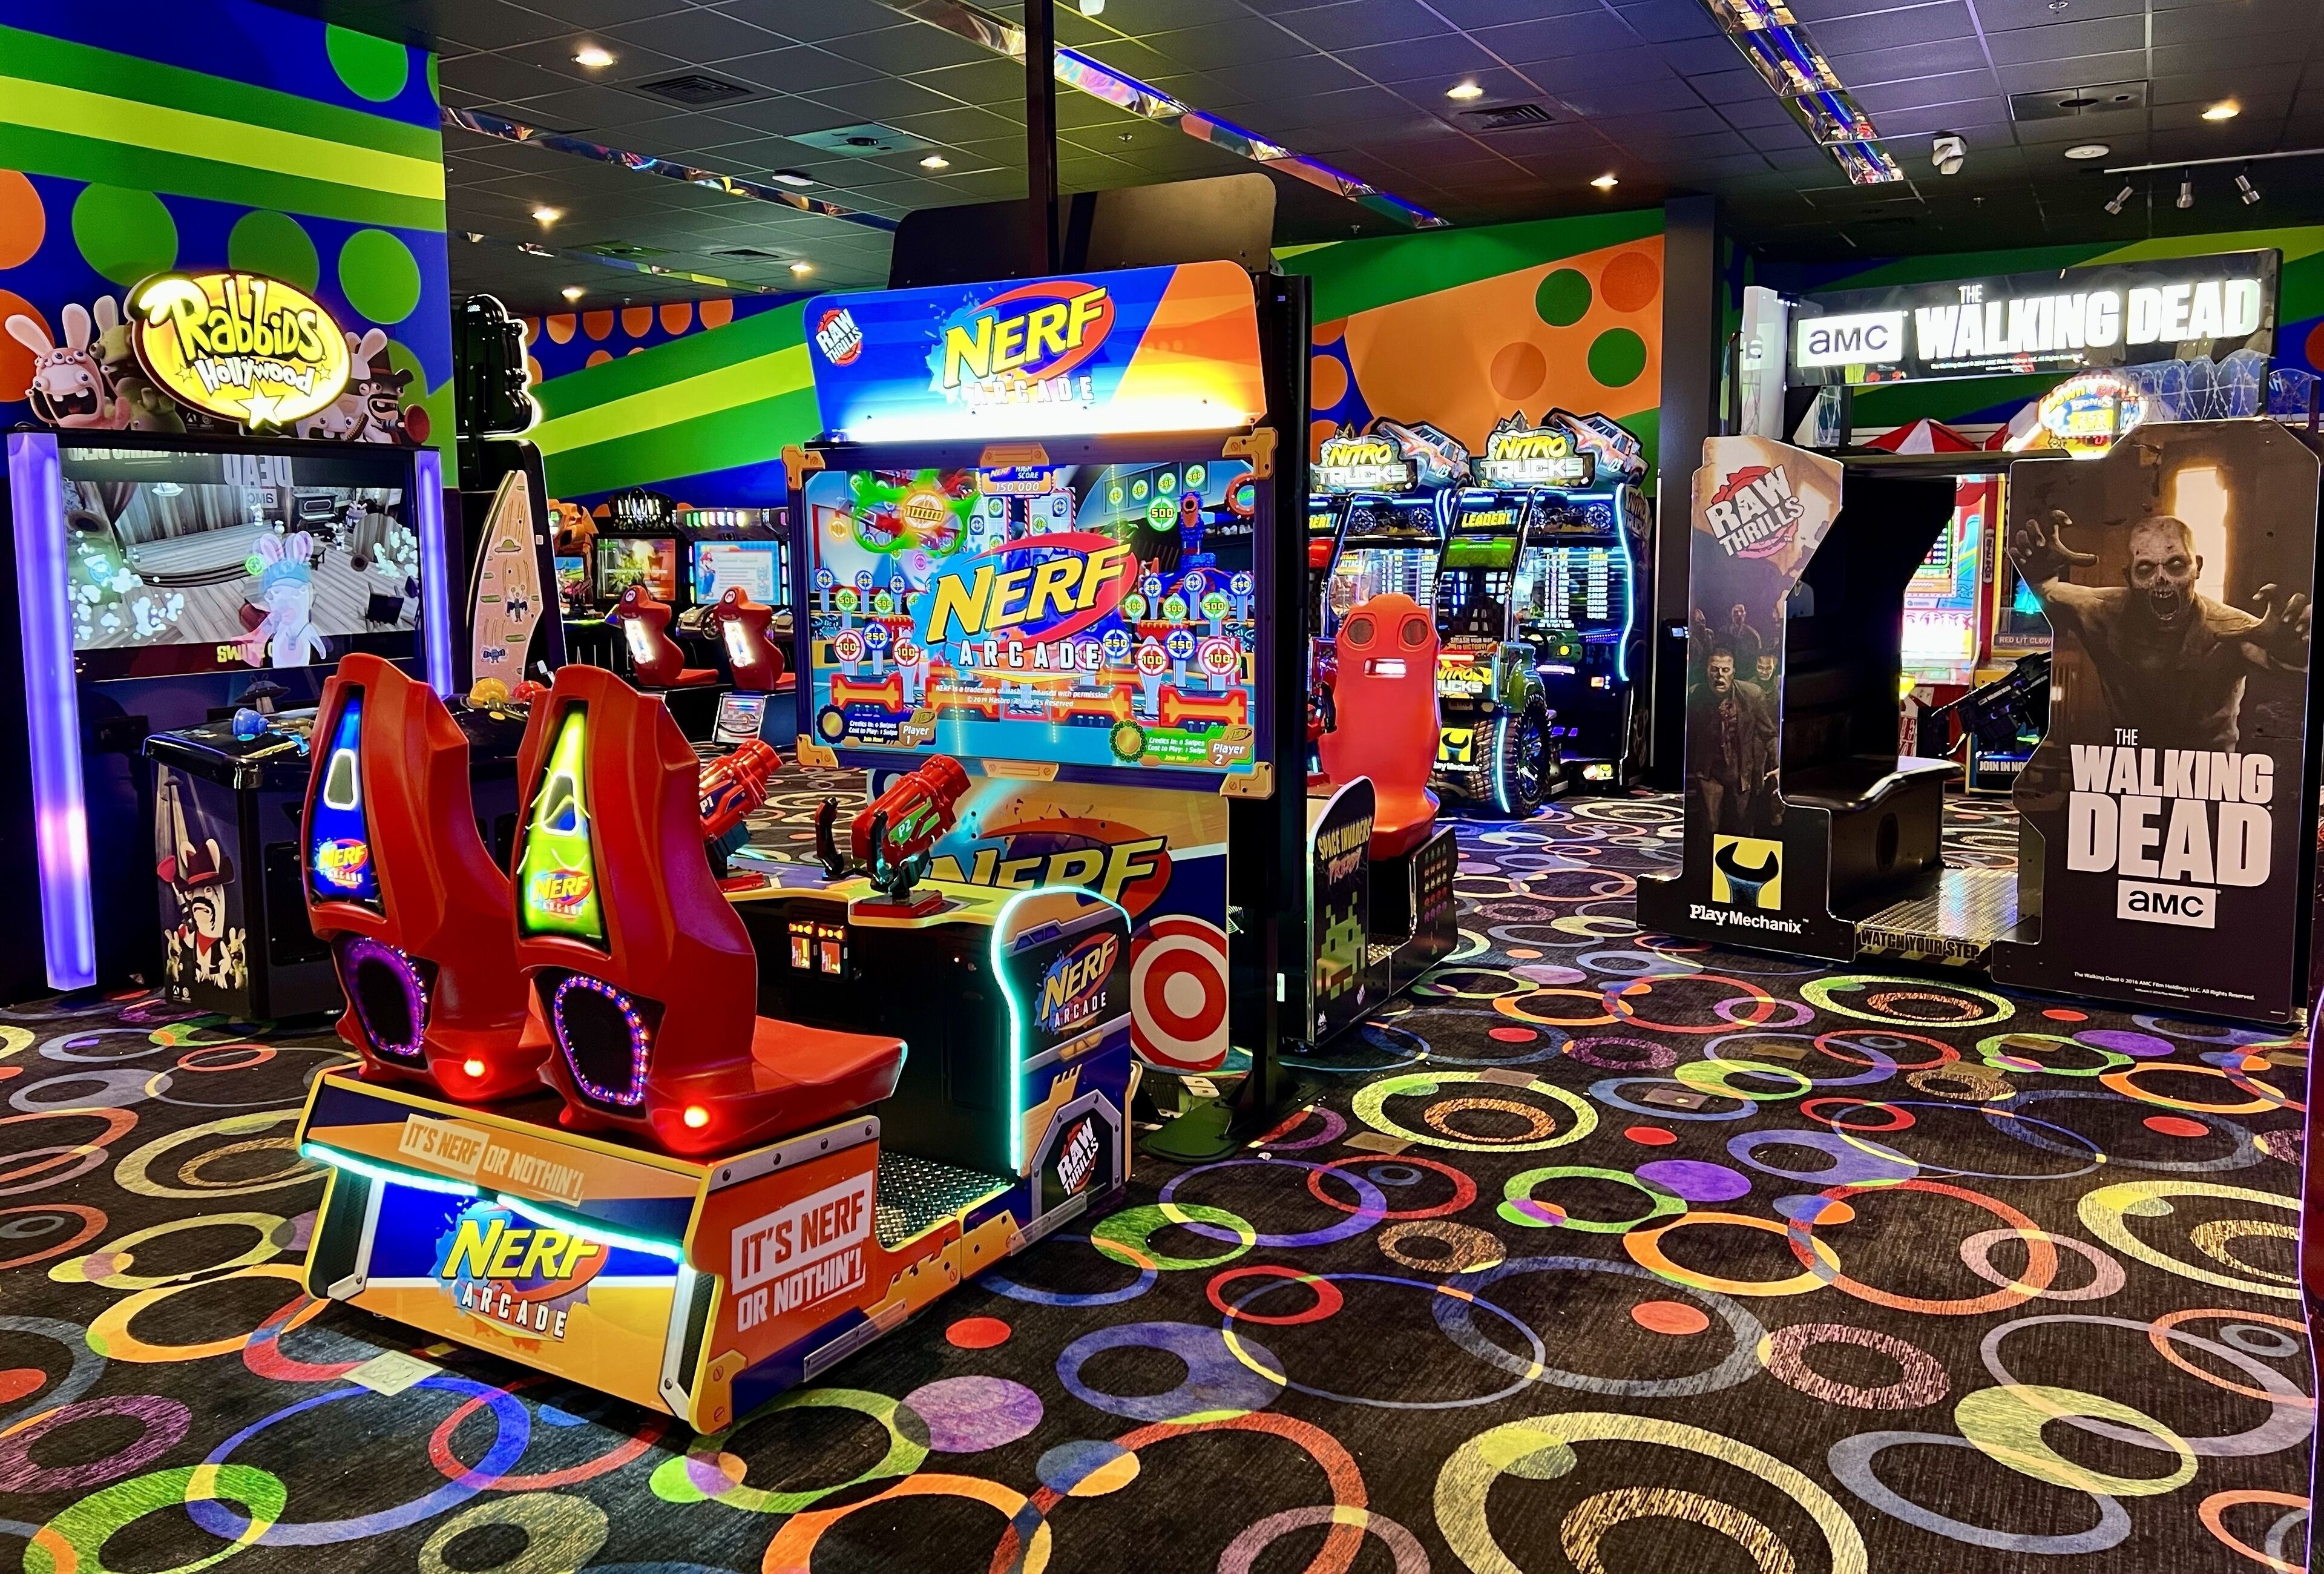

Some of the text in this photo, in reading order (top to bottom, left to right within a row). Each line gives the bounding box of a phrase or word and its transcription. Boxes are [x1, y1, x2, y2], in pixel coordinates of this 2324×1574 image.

[1958, 284, 1982, 304] THE
[1915, 278, 2262, 361] WALKING DEAD
[816, 308, 855, 354] RAW
[942, 287, 1108, 387] NERF
[826, 327, 862, 363] THRILLS
[195, 357, 316, 395] Hollywood
[974, 376, 1094, 406] ARCADE
[1315, 464, 1407, 484] TRUCKS
[1435, 464, 1451, 478] 03
[1480, 457, 1584, 478] TRUCKS
[1607, 458, 1624, 473] 03
[996, 482, 1039, 493] 150,000
[1705, 464, 1792, 539] RAW
[1151, 509, 1173, 518] 500
[1462, 512, 1512, 528] LEADER!
[1719, 496, 1805, 556] THRILLS
[926, 544, 1131, 645] NERF
[865, 632, 886, 640] 250
[1105, 639, 1128, 647] 250
[1169, 640, 1193, 649] 250
[839, 643, 856, 651] 100
[898, 648, 915, 656] 100
[959, 639, 1100, 670] ARCADE
[1142, 656, 1163, 665] 100
[1209, 654, 1230, 663] 100
[1437, 680, 1483, 693] UCKS
[902, 725, 929, 736] Player
[907, 735, 910, 744] 1
[1225, 728, 1252, 740] NERF
[2114, 728, 2138, 746] THE
[1212, 743, 1245, 754] Player
[1215, 754, 1223, 765] 2
[1980, 761, 2027, 772] JOIN IN NO
[2070, 744, 2274, 804] WALKING
[700, 795, 714, 813] P1
[898, 819, 911, 837] P2
[1318, 817, 1372, 860] SPACE INVADERS
[2067, 791, 2273, 887] DEAD
[320, 845, 367, 869] NERF
[533, 875, 589, 901] NERF
[543, 901, 583, 915] ARCADE
[1689, 904, 1802, 934] Play Mechanix
[1860, 928, 1980, 959] WATCH YOUR STEP
[1041, 934, 1116, 1021] NERF
[2084, 972, 2104, 981] Walking
[2165, 983, 2189, 992] Holdings
[1055, 992, 1106, 1027] ARCADE
[405, 1122, 585, 1199] IT'S NERF OR NOTHIN'!
[1057, 1118, 1093, 1185] RAW
[1063, 1138, 1098, 1196] THRILLS
[741, 1189, 865, 1280] IT'S NERF
[442, 1219, 601, 1280] NERF
[737, 1247, 861, 1332] OR NOTHIN'!
[461, 1281, 568, 1339] ARCADE
